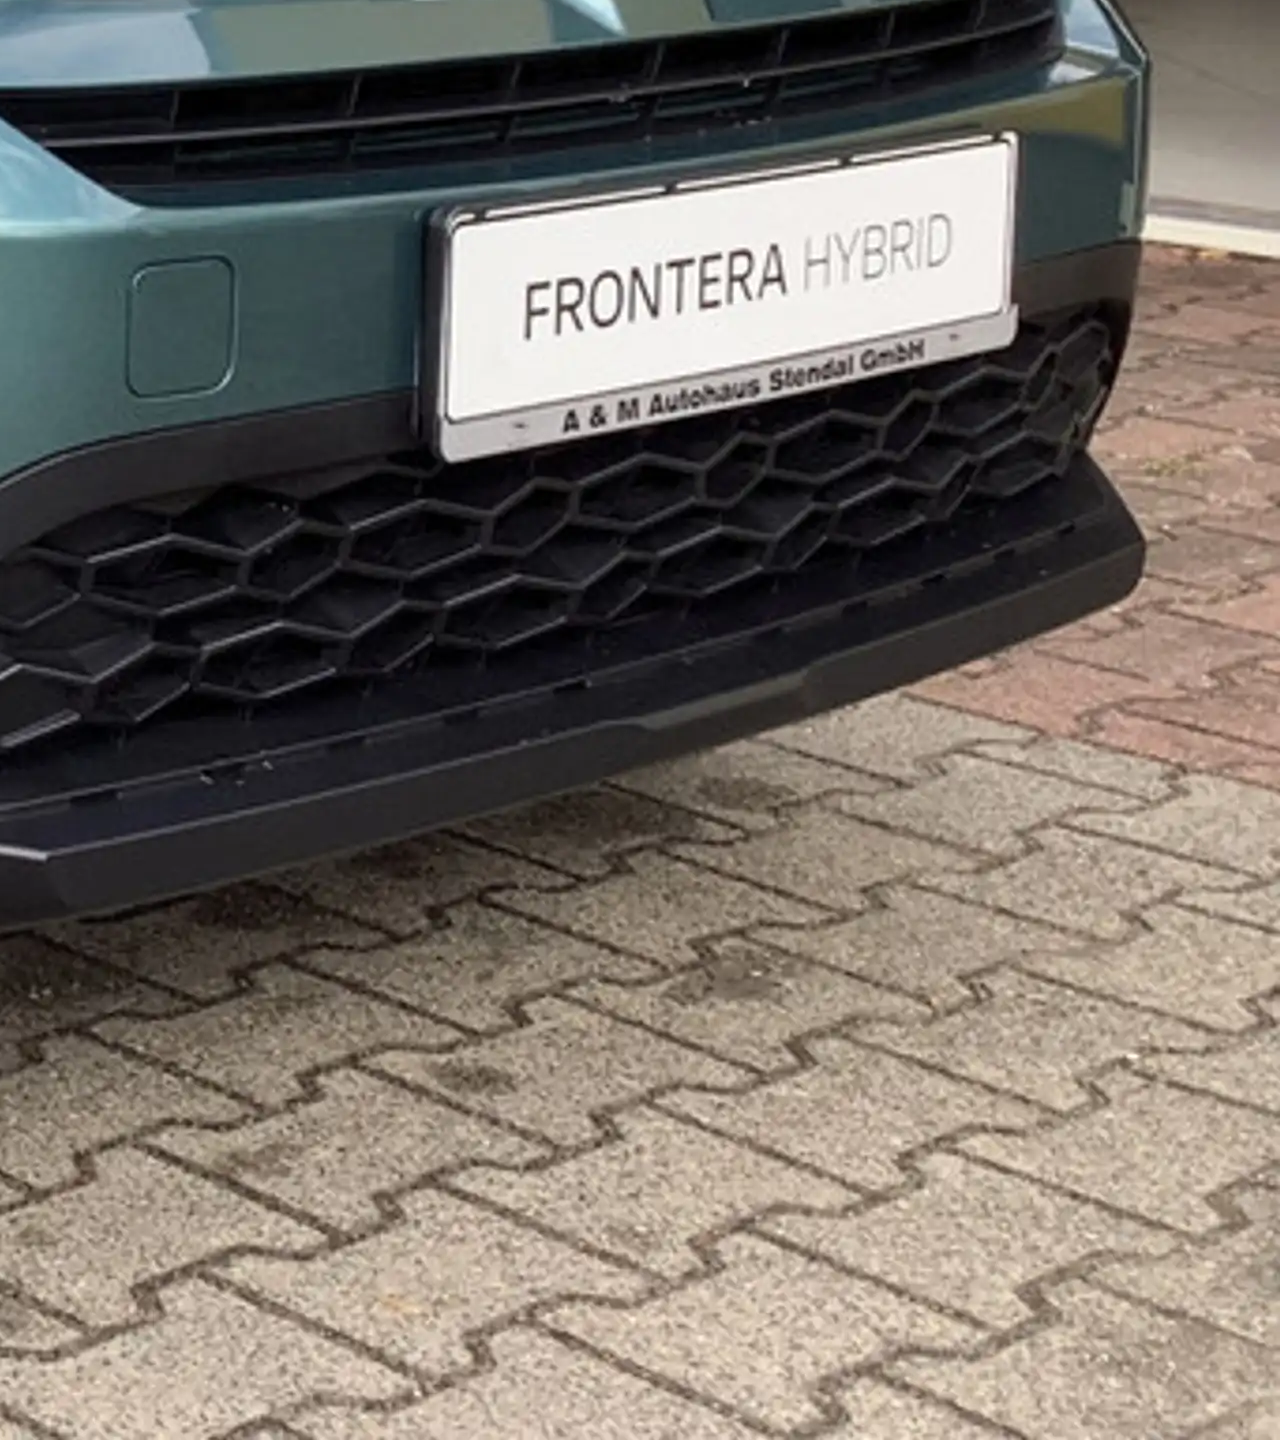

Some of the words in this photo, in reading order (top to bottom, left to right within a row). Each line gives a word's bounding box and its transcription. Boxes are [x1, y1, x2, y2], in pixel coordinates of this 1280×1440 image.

[523, 243, 788, 341] FRONTERA
[803, 213, 954, 293] HYBRID
[562, 409, 581, 434] A
[588, 404, 608, 428] &
[616, 396, 641, 423] M
[648, 377, 761, 418] Autohaus
[768, 353, 854, 392] Stendal
[859, 337, 926, 372] GmbH
